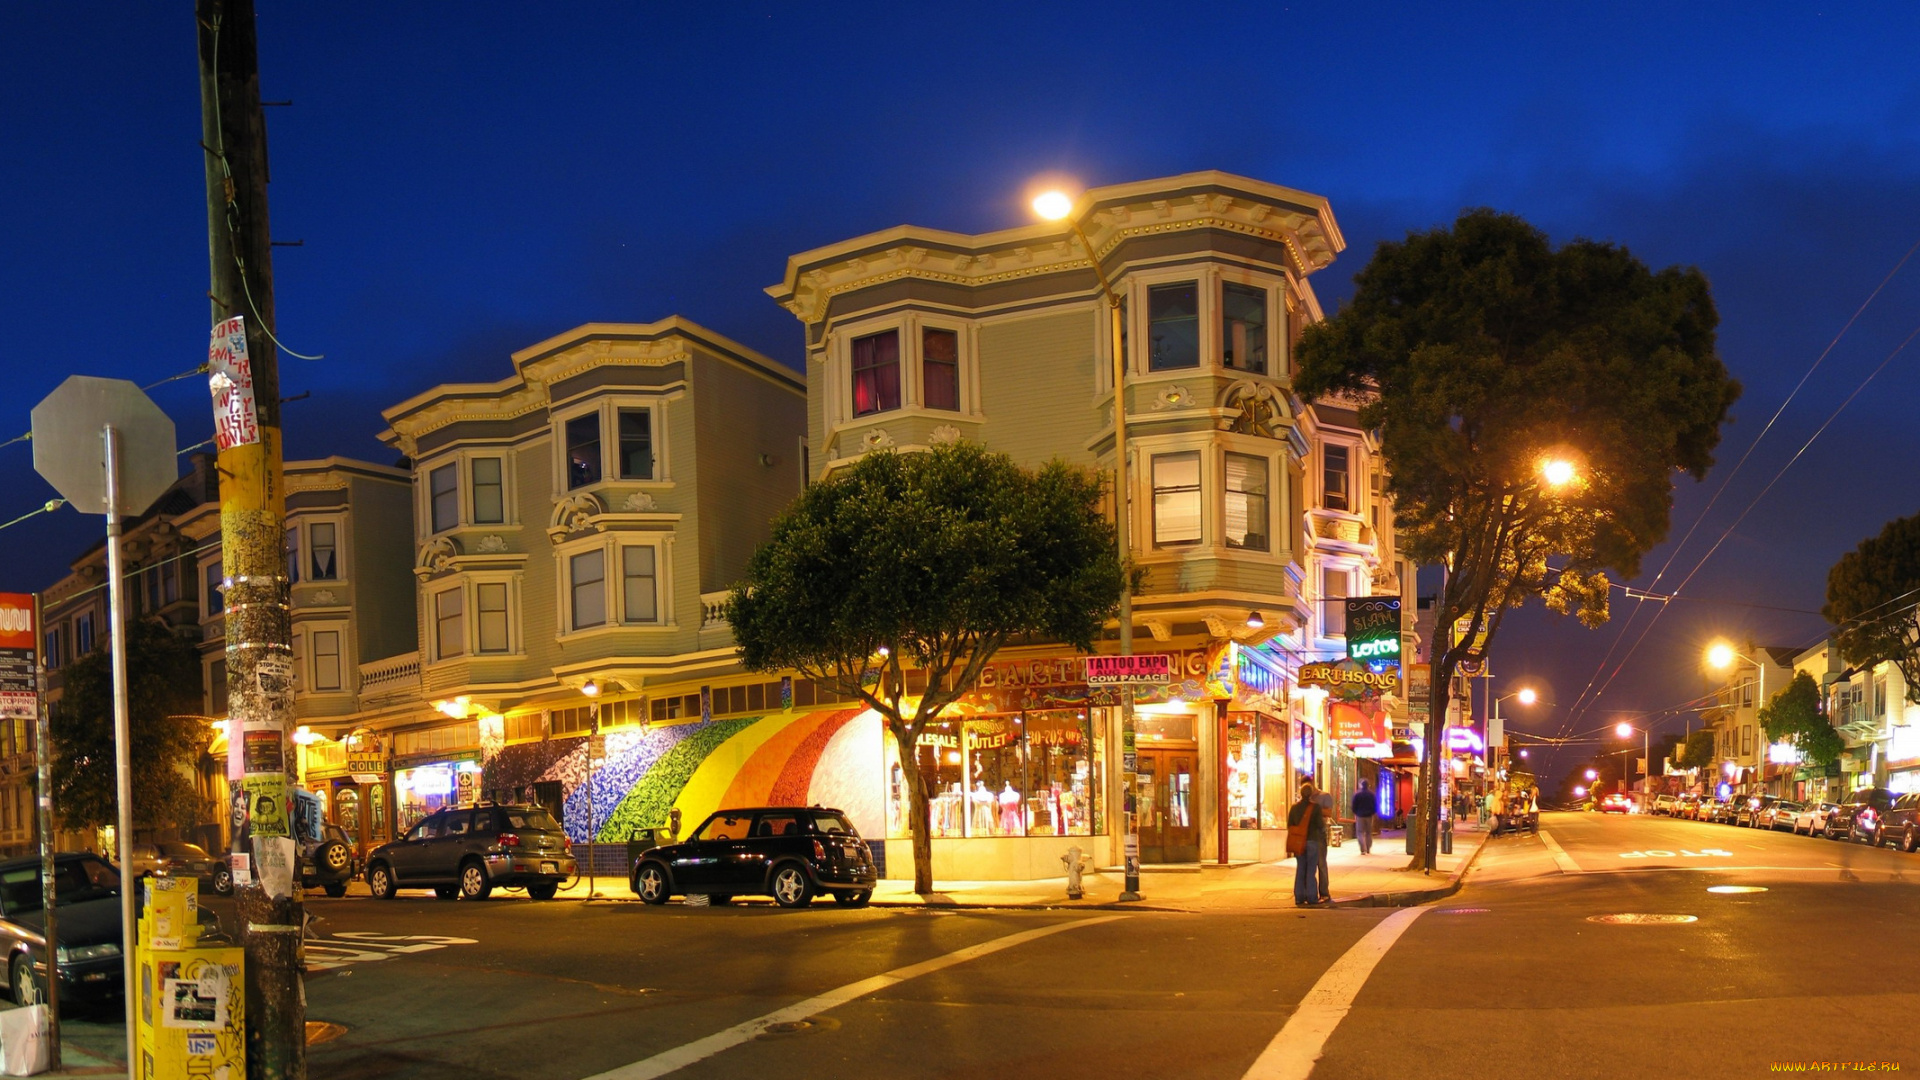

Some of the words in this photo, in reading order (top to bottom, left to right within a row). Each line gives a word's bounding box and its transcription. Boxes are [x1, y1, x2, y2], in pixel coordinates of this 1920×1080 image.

[1353, 610, 1395, 631] SIAM
[1088, 657, 1135, 669] TATTOO
[1140, 656, 1168, 668] EXPO
[1302, 668, 1396, 689] EARTHSONG
[969, 733, 1007, 750] OUTLET
[1066, 731, 1082, 742] OFF
[350, 762, 382, 770] COLE
[1619, 849, 1733, 858] STOP
